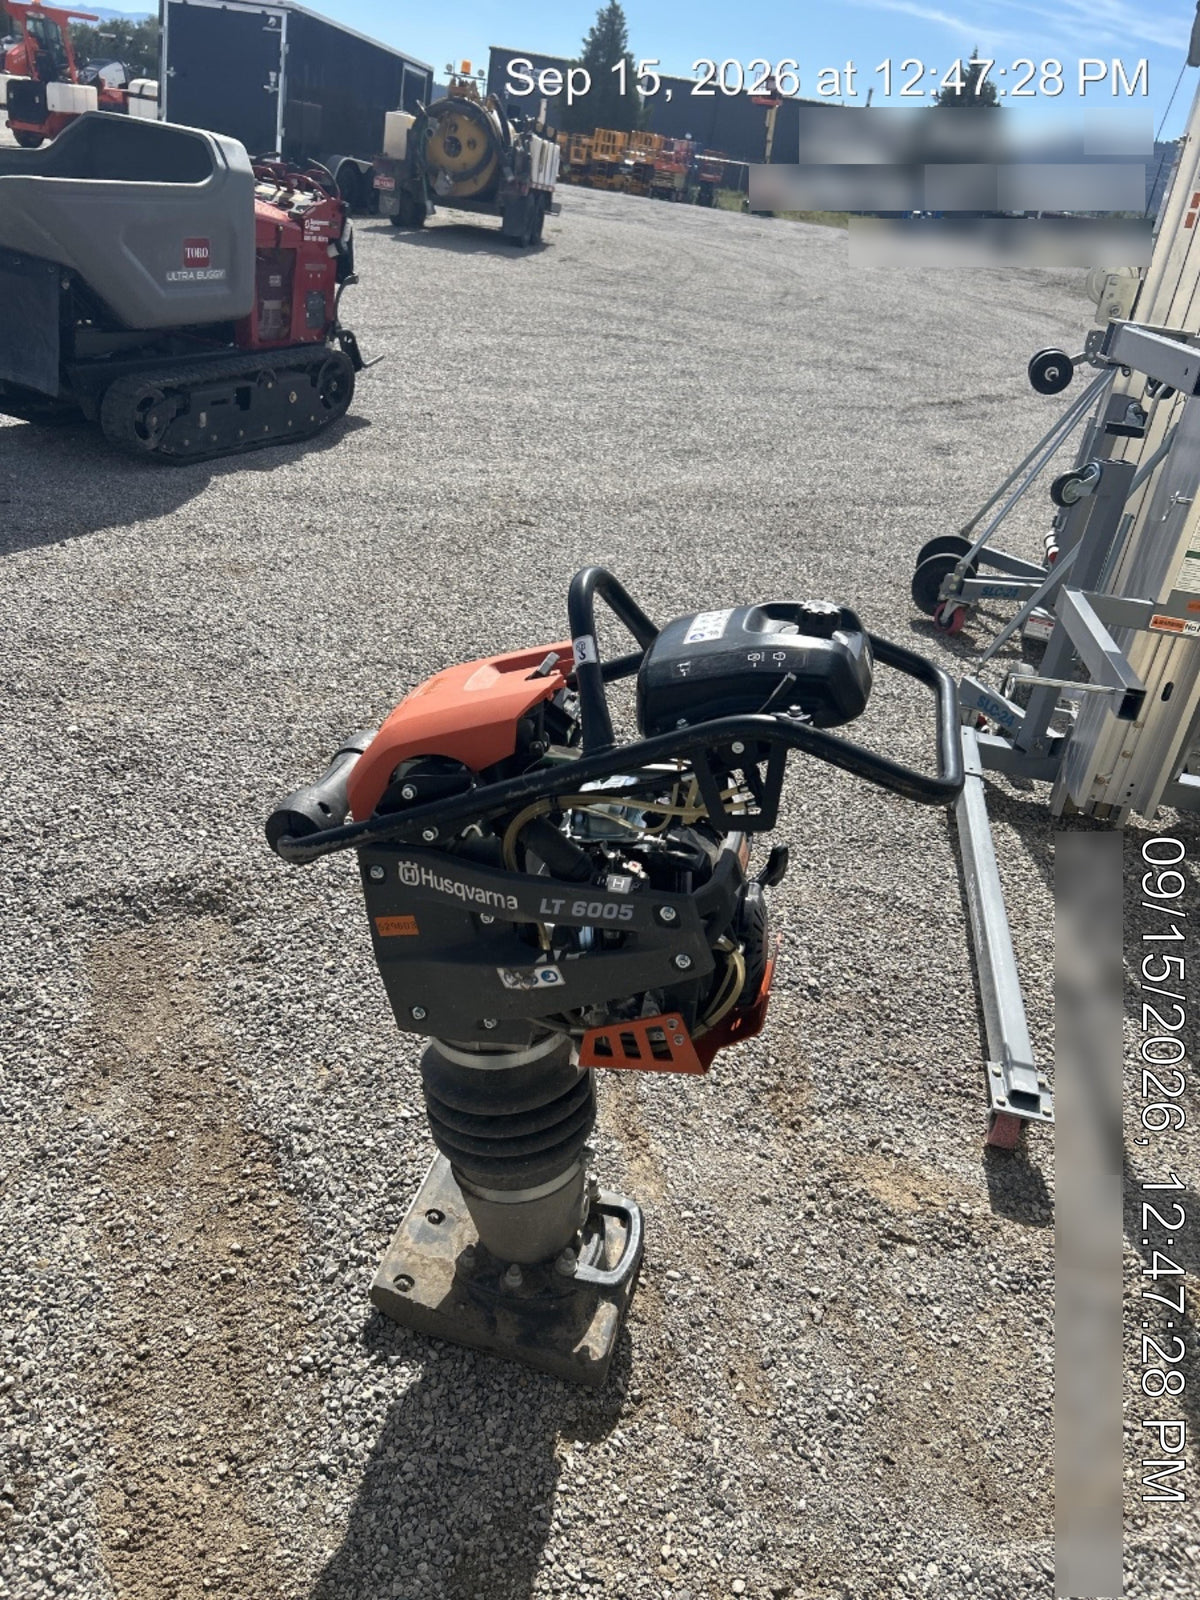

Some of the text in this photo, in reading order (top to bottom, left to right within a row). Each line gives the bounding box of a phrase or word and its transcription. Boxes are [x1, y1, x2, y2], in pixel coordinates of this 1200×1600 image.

[184, 247, 209, 258] TORO
[166, 269, 226, 281] ULTRA BUGGY
[977, 695, 1015, 727] SLC-24
[421, 867, 519, 910] Husqvarna
[539, 898, 635, 921] LT 6005
